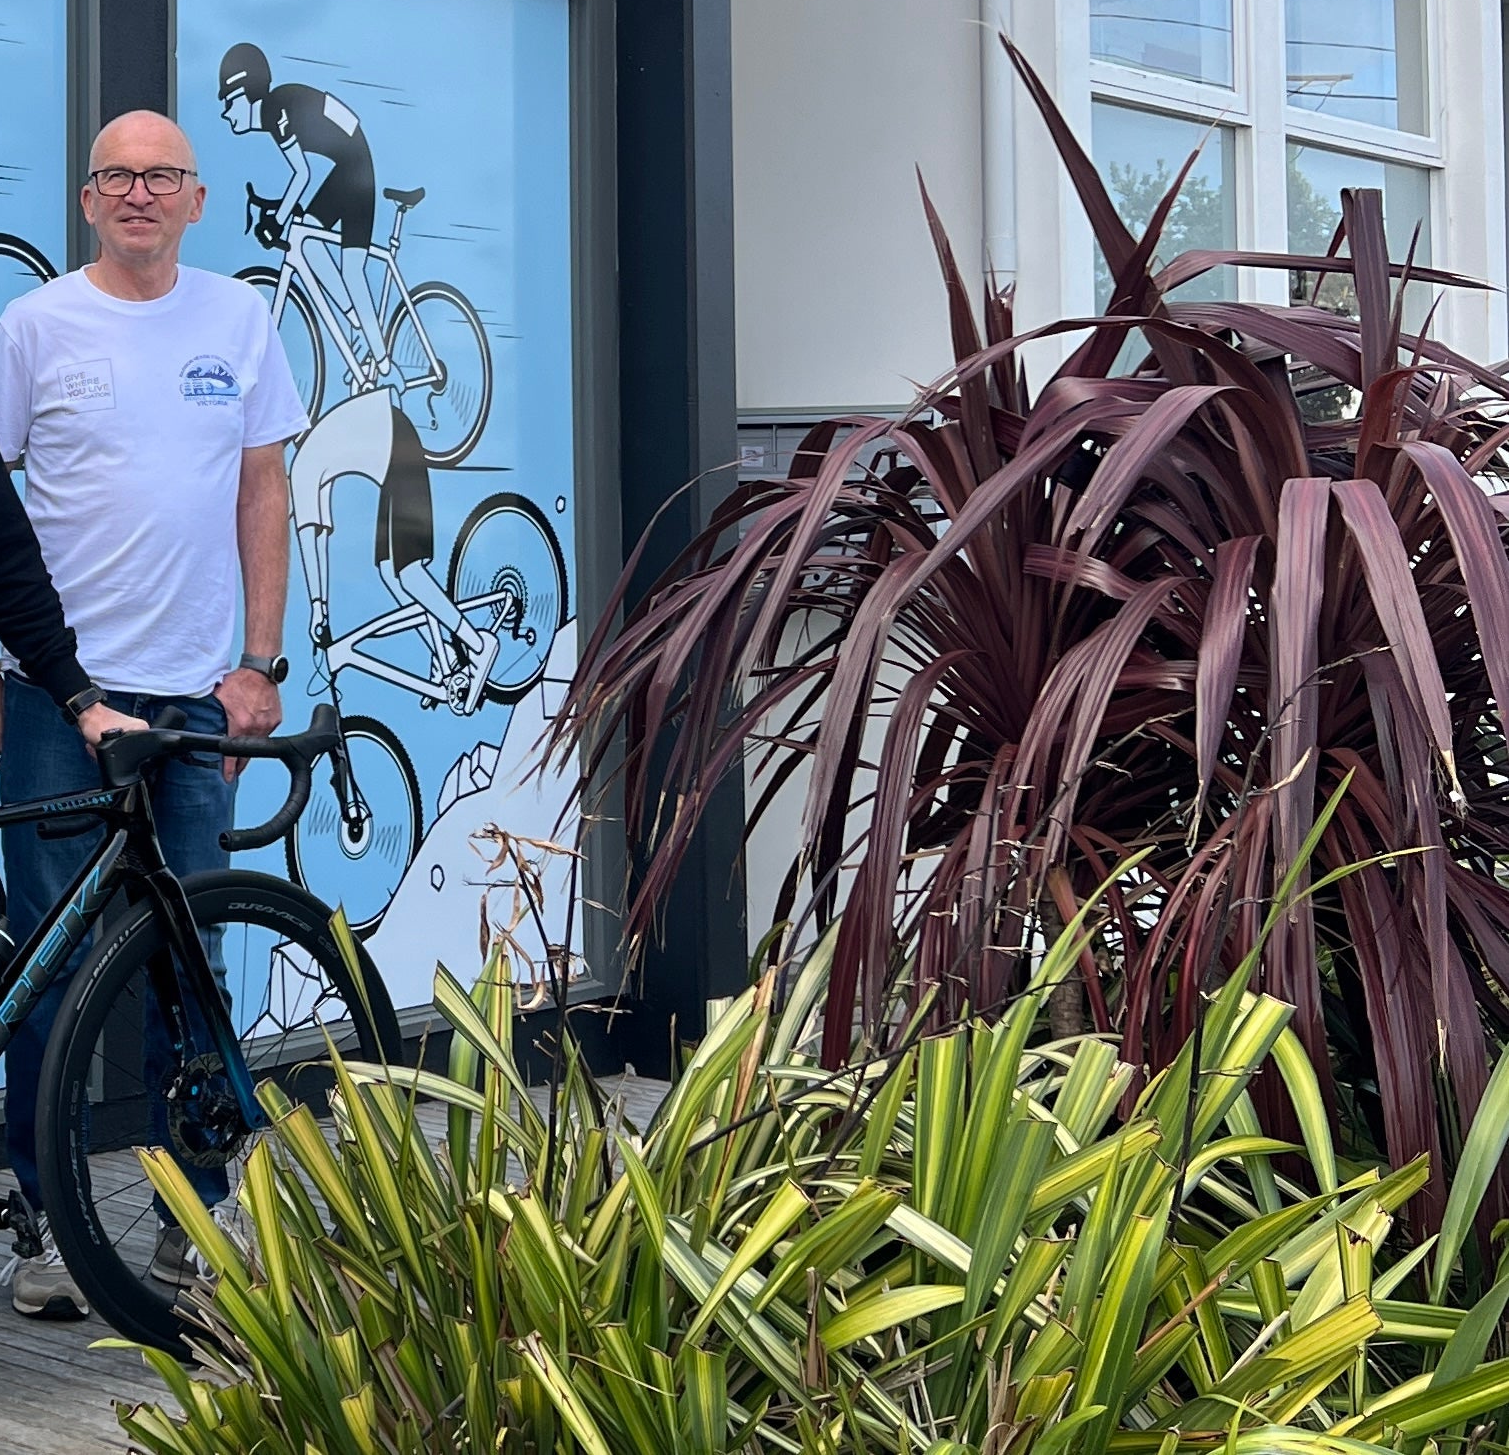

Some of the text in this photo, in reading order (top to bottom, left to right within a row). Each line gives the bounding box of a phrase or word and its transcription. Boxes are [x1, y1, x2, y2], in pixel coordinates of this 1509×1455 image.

[65, 372, 85, 383] GIVE
[66, 377, 99, 390] WHERE
[67, 383, 109, 397] YOU LIVE
